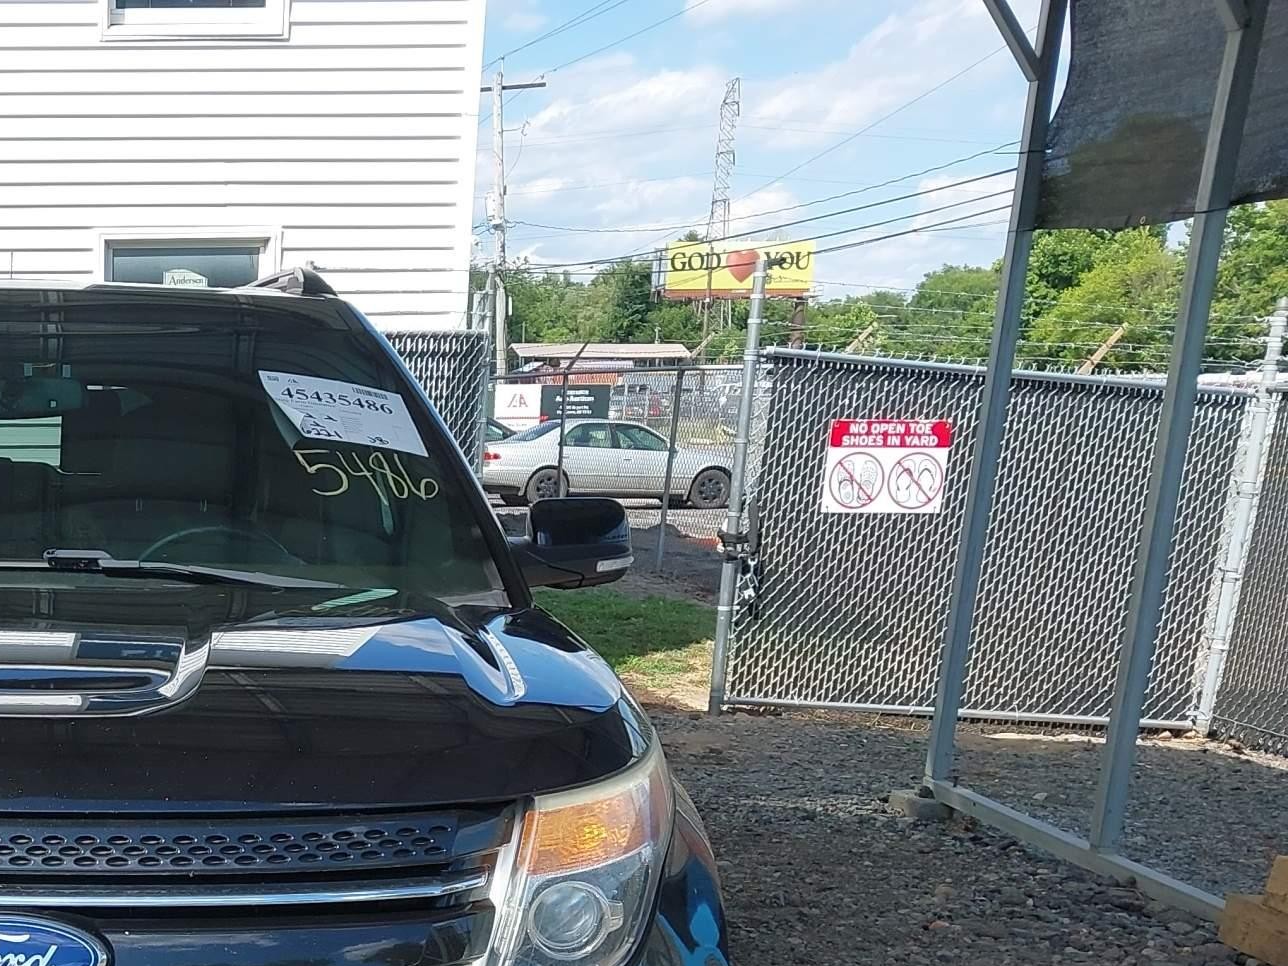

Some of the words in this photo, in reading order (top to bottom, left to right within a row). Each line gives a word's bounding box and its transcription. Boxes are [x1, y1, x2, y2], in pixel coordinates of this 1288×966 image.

[670, 252, 722, 271] GOD
[764, 251, 812, 270] YOU
[168, 275, 204, 286] Andersen
[280, 387, 394, 415] 45435486
[849, 423, 867, 434] NO
[871, 423, 906, 434] OPEN
[909, 423, 934, 434] TOE
[842, 435, 884, 446] SHOES
[887, 435, 901, 446] IN
[904, 435, 939, 446] YARD
[293, 450, 439, 506] 5486
